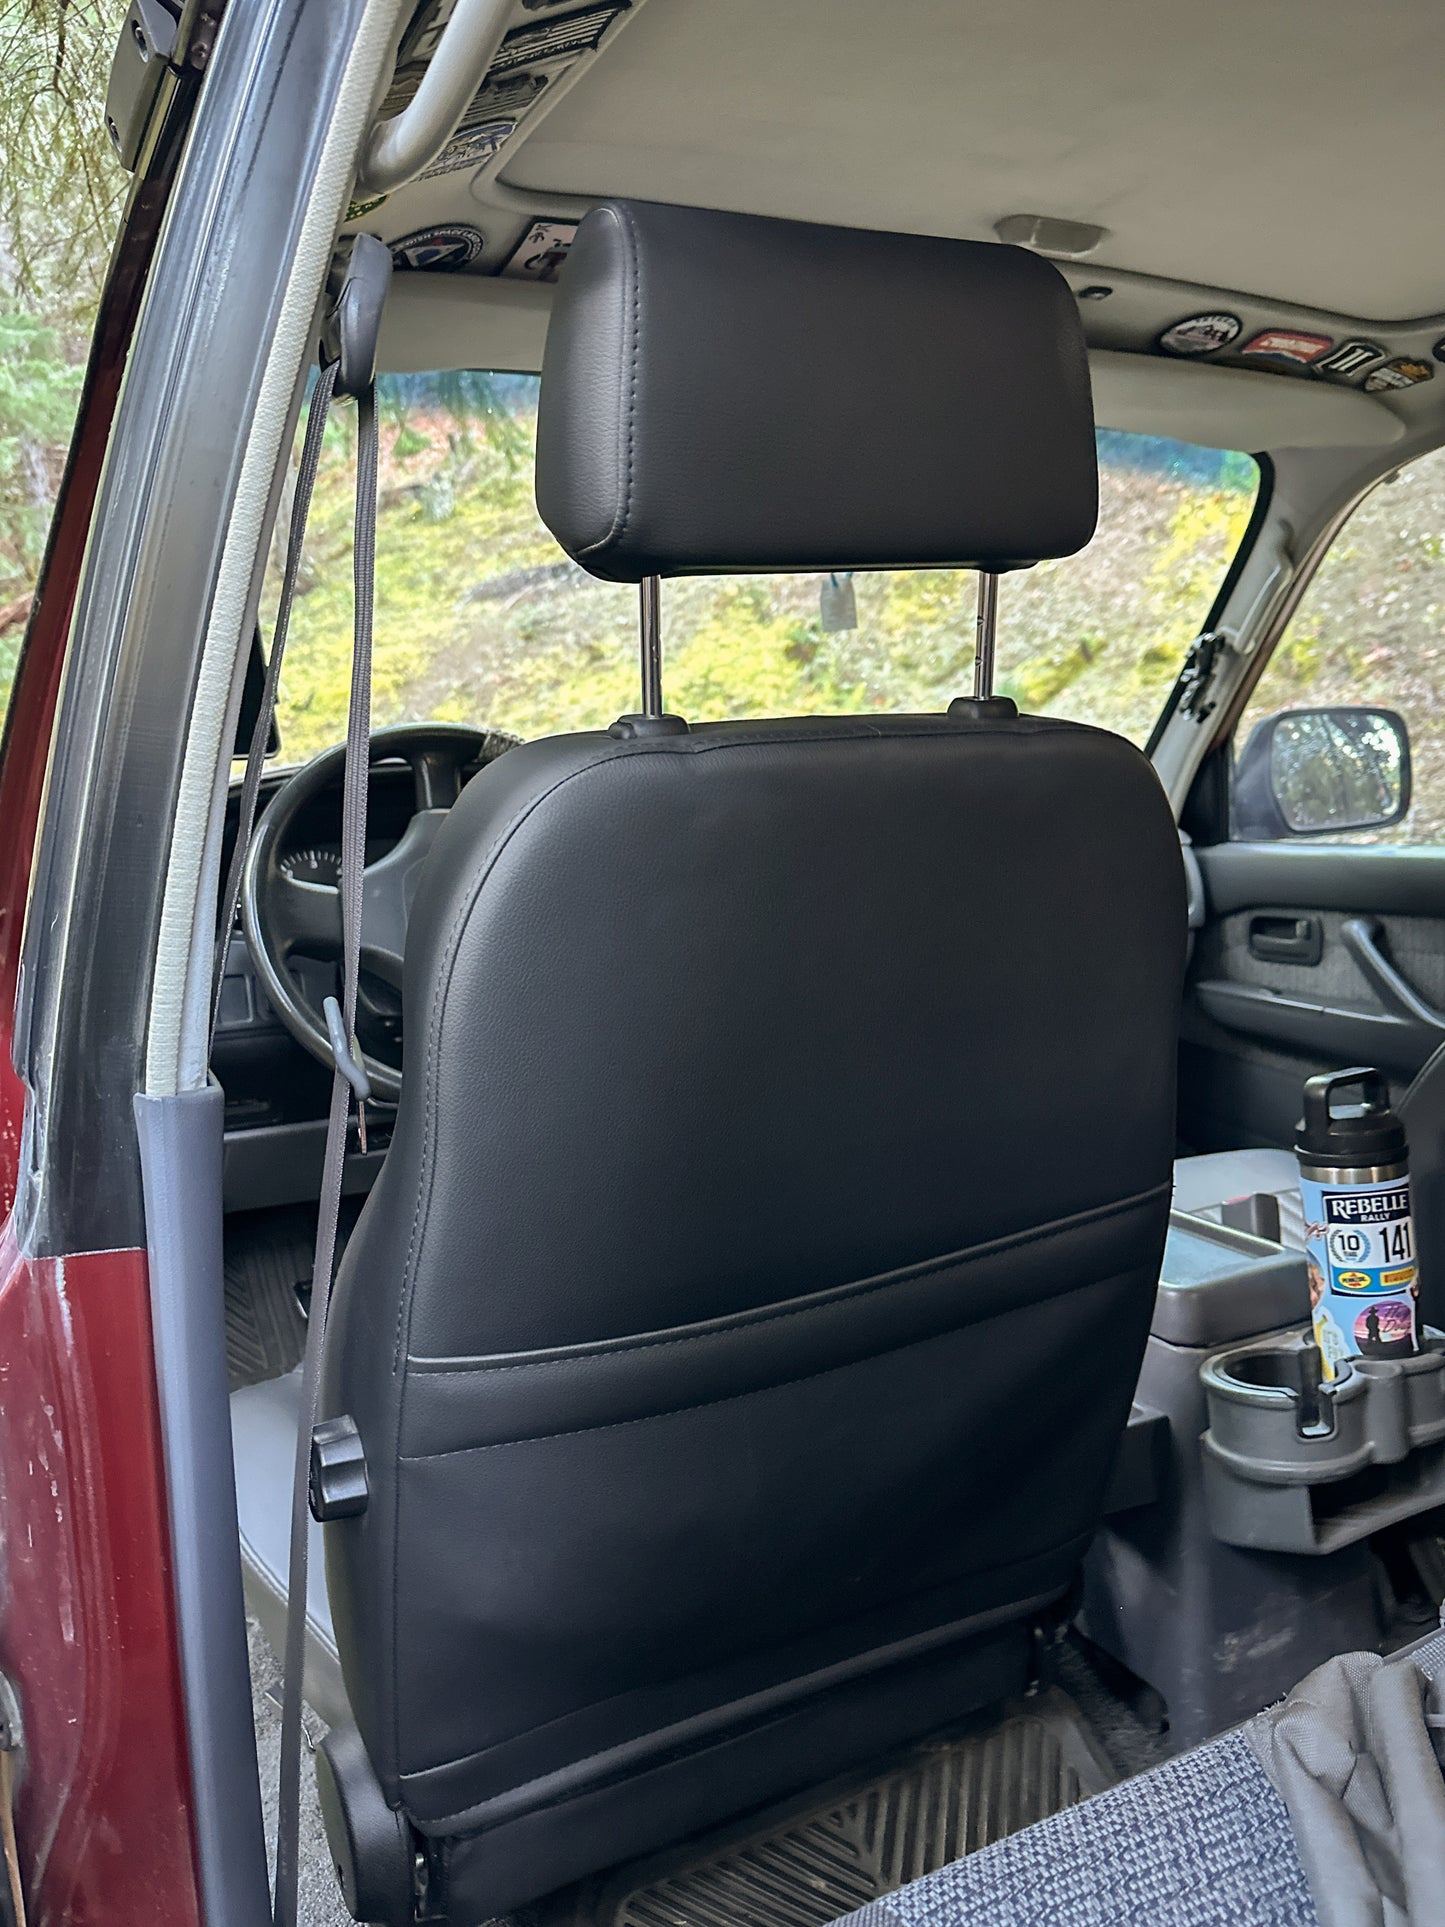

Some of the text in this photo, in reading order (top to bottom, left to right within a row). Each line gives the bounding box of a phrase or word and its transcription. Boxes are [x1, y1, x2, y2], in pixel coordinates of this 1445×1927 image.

[1332, 1194, 1408, 1219] REBELLE
[1360, 1212, 1391, 1222] RALLY
[1338, 1235, 1360, 1251] 10
[1379, 1222, 1411, 1263] 141
